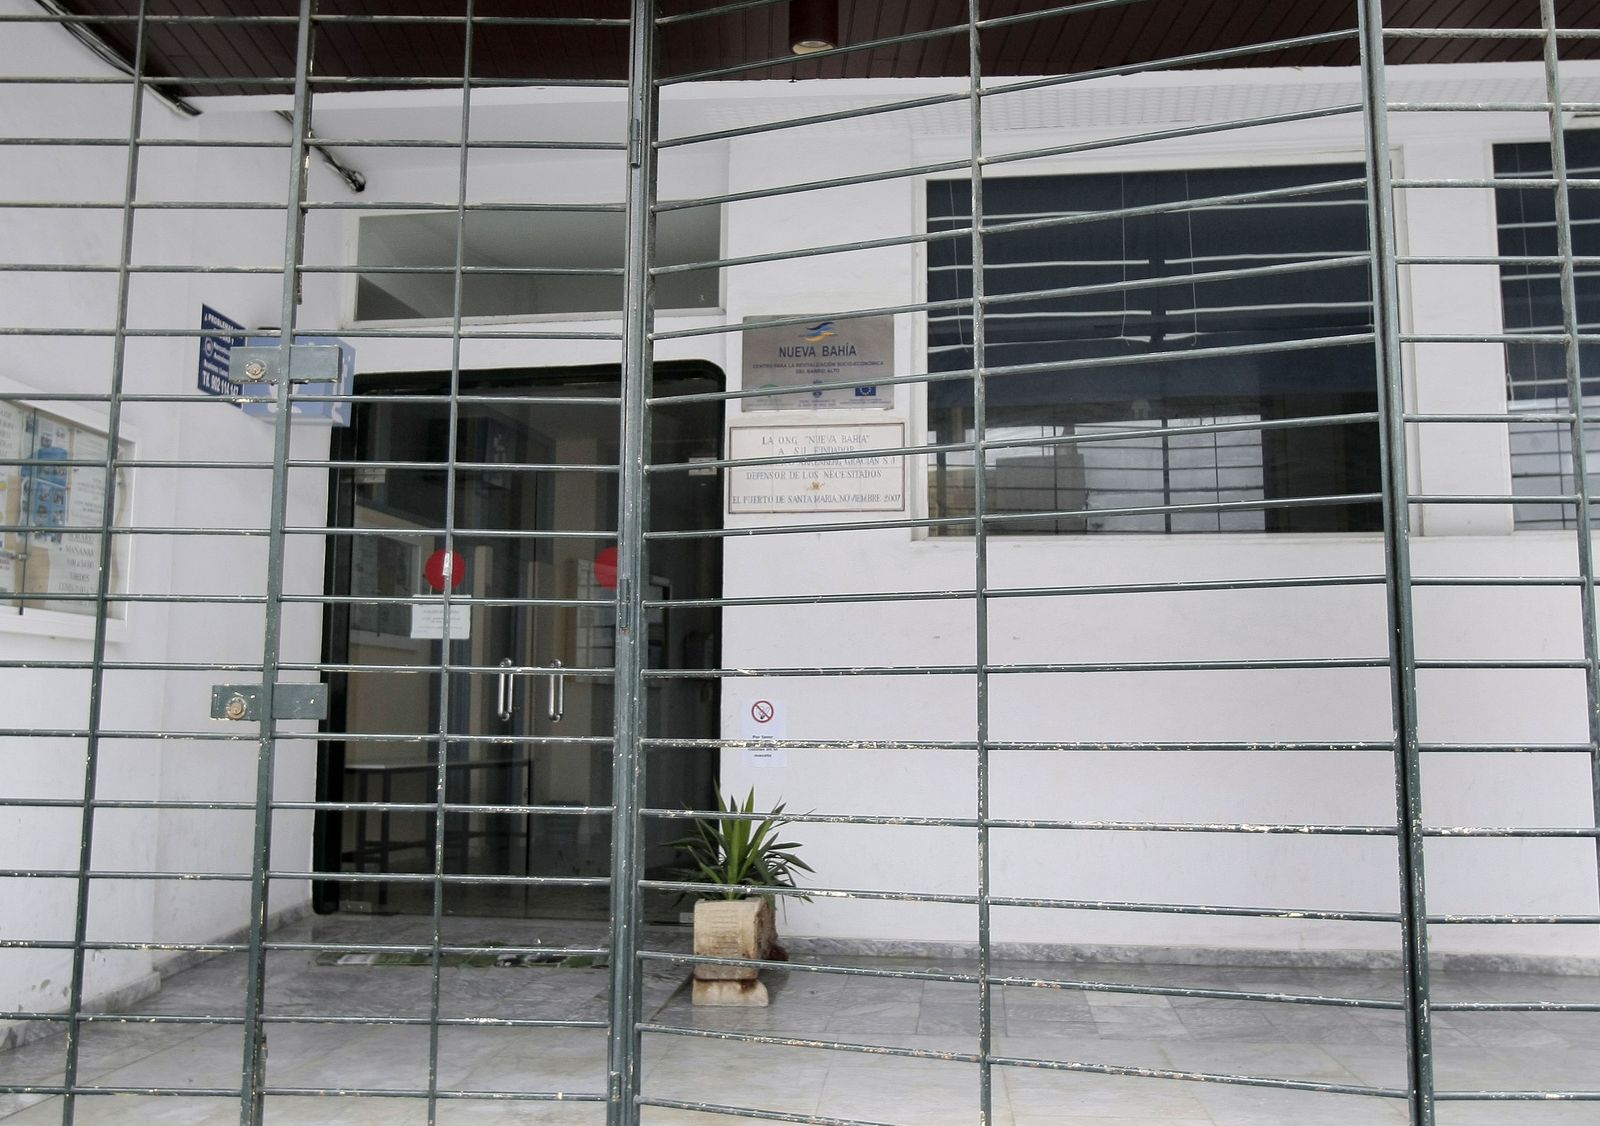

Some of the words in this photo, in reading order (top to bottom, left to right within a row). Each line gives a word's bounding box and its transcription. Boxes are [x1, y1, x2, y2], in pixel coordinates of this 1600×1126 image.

[779, 346, 815, 358] NUEVA
[822, 343, 857, 357] BAHÍA
[762, 436, 774, 446] LA
[778, 447, 785, 456] A
[793, 446, 807, 455] SU
[746, 471, 786, 481] DEFENSOR
[789, 471, 800, 480] DE
[802, 470, 819, 480] LOS
[823, 469, 882, 480] NECESITADOS
[732, 495, 740, 505] EL
[743, 495, 774, 504] PUERTO
[776, 495, 787, 504] DE
[788, 494, 815, 504] SANTA
[839, 493, 880, 503] NOVIEMBRE
